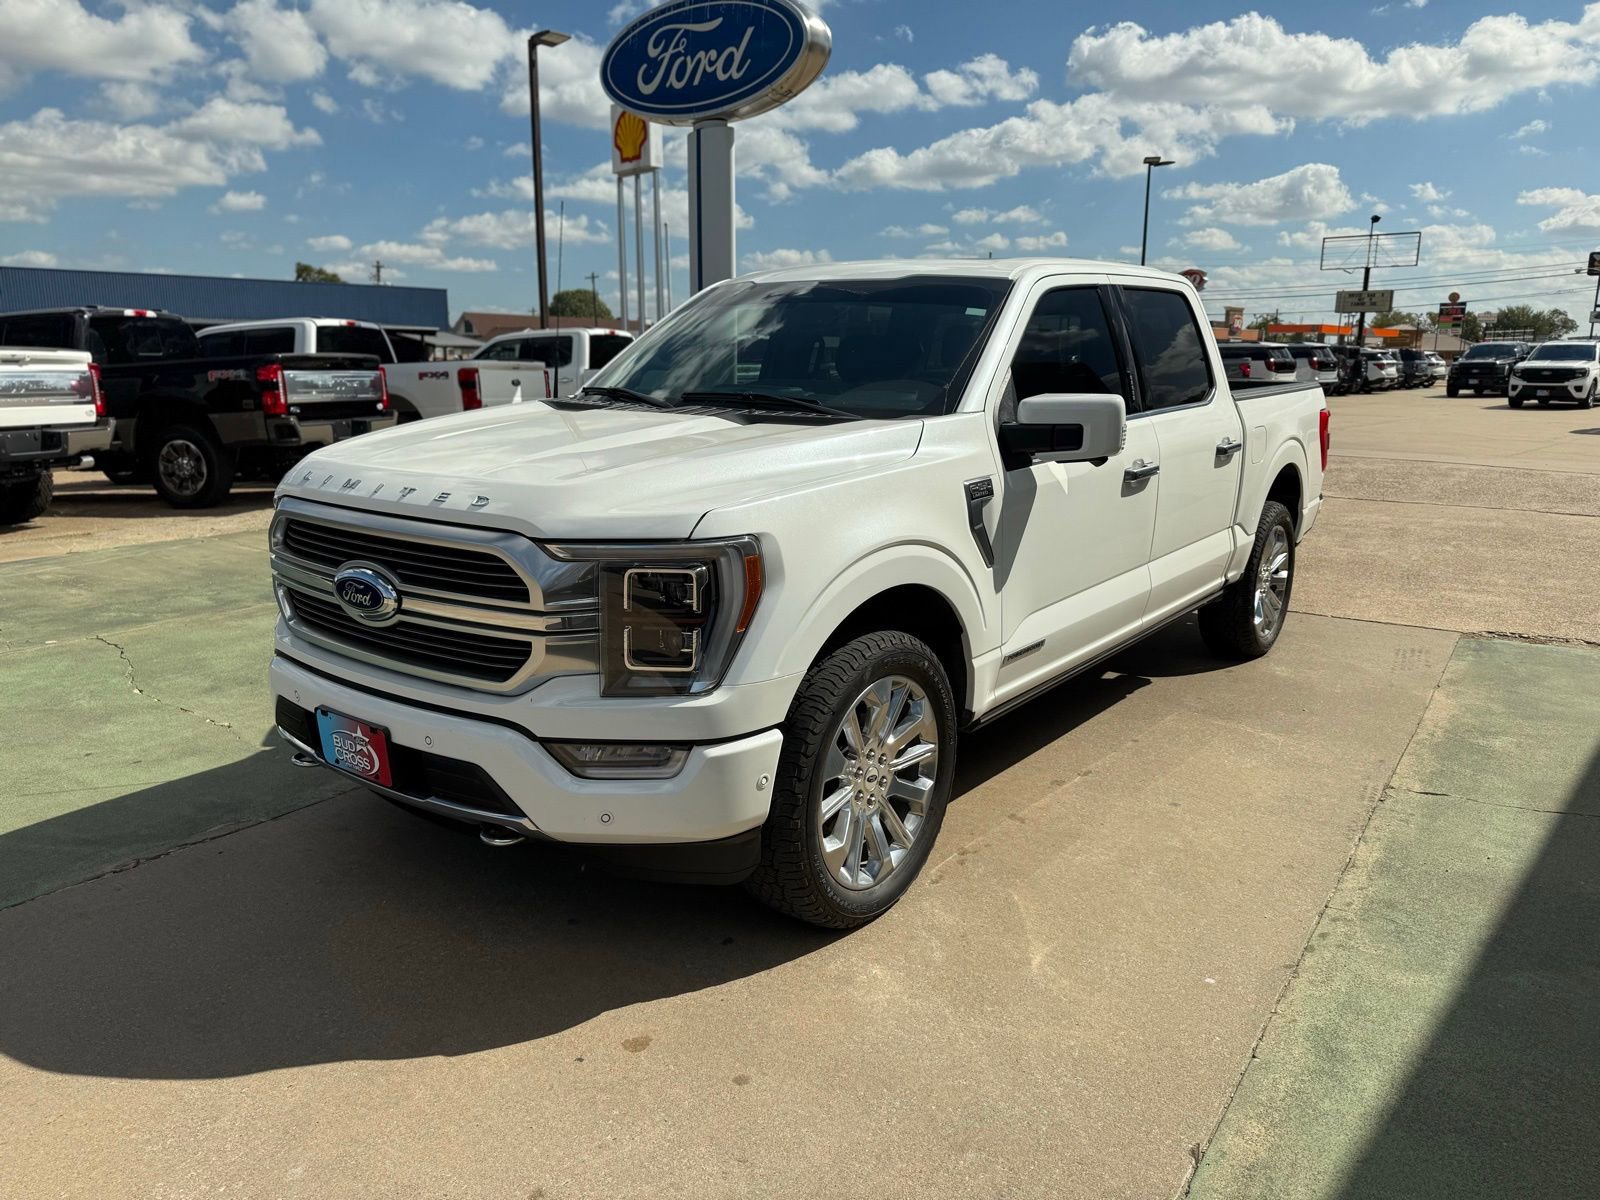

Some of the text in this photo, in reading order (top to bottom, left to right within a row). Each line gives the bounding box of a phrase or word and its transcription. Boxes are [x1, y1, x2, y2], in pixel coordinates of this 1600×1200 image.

[637, 17, 755, 95] Ford
[418, 371, 449, 380] FX4
[303, 471, 490, 507] LIMITED
[342, 581, 373, 606] Ford
[332, 734, 355, 752] BUD
[335, 747, 371, 770] CROSS
